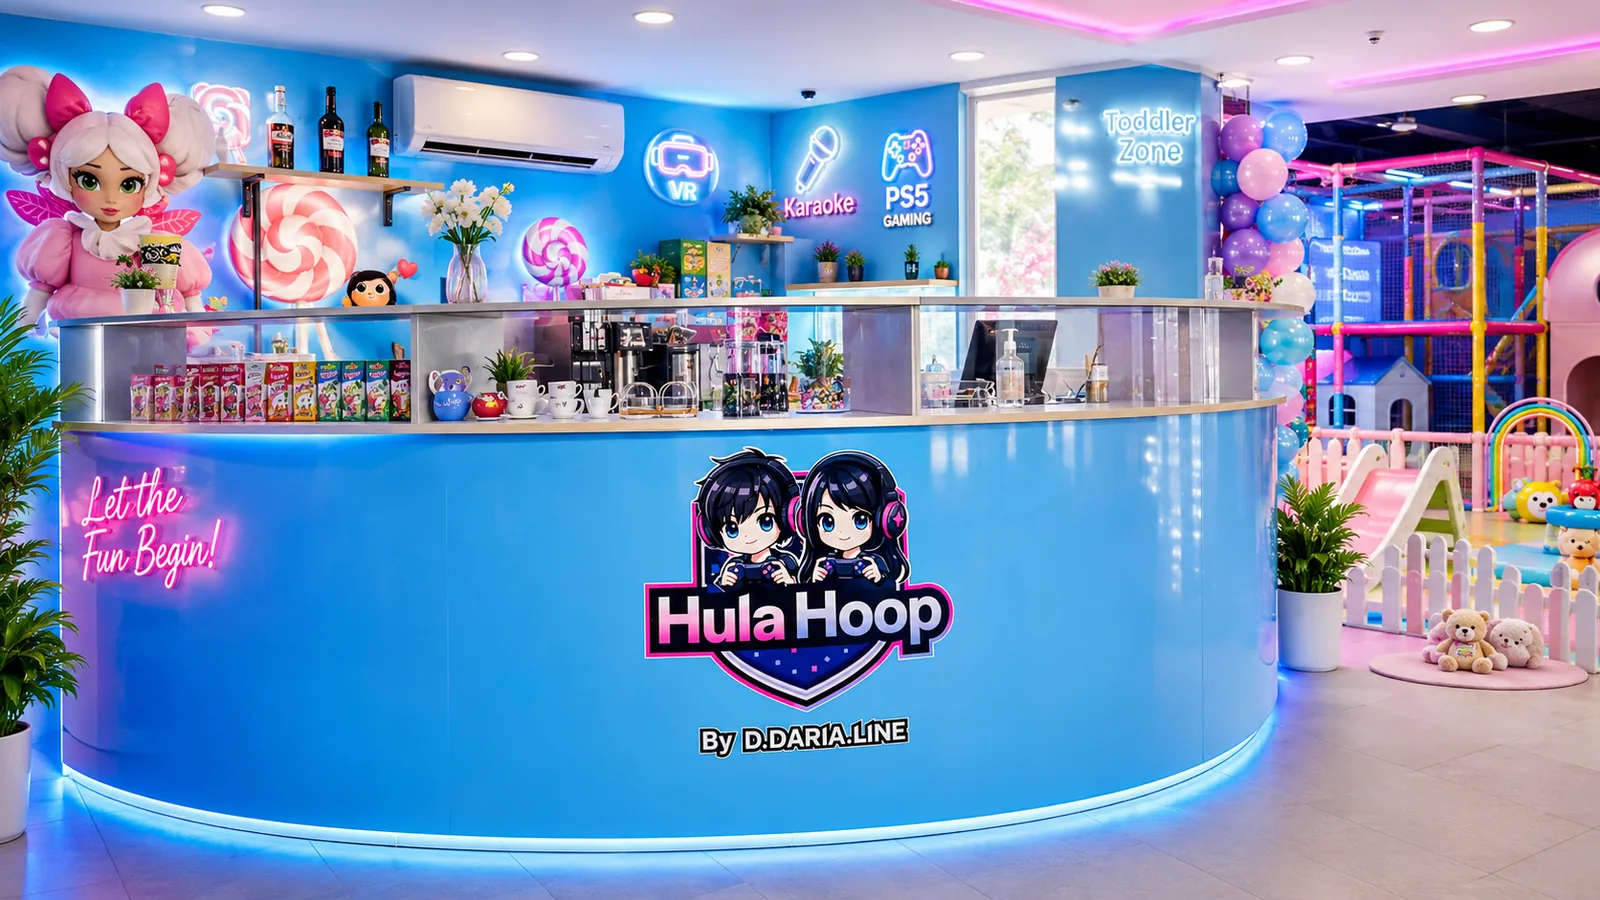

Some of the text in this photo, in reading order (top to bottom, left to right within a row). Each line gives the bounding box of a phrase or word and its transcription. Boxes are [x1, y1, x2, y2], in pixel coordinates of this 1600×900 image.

[1103, 108, 1196, 135] Toddler
[1117, 137, 1183, 165] Zone
[668, 180, 697, 201] VR
[885, 183, 929, 210] PS5
[784, 193, 855, 218] Karaoke
[883, 211, 931, 228] GAMING
[81, 466, 183, 526] Let the
[82, 518, 221, 589] Fun Begin!
[657, 590, 942, 645] Hula Hoop
[701, 720, 907, 756] By D.DARIA.LINE
